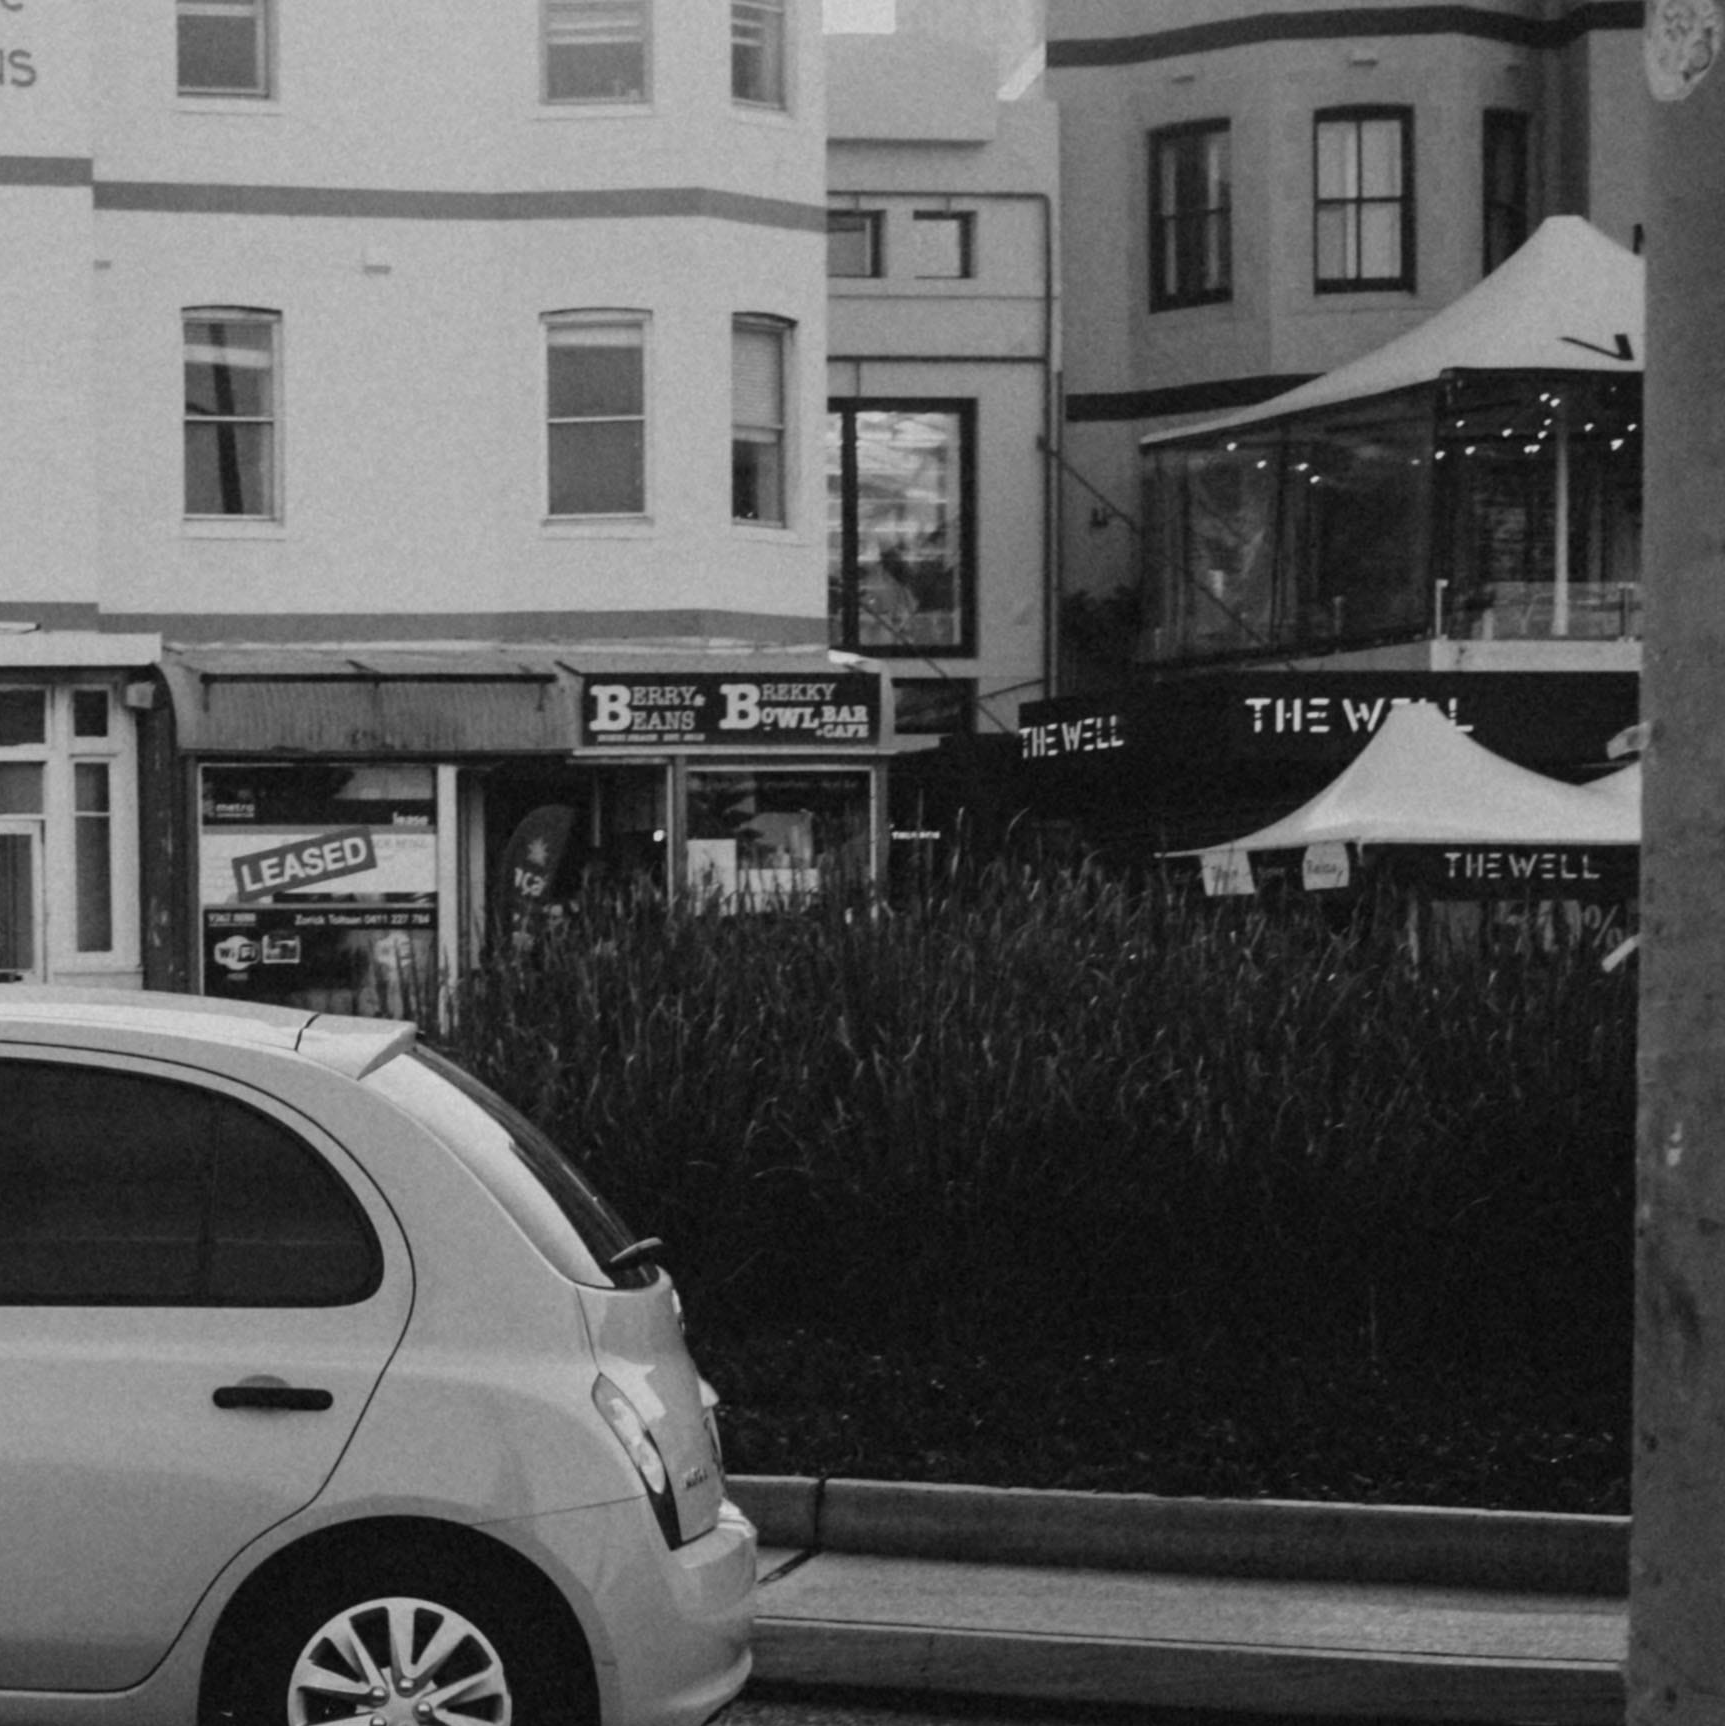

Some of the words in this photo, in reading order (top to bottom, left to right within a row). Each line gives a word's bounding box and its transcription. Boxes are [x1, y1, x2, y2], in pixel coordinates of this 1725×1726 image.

[821, 705, 869, 723] BAR
[1245, 698, 1332, 733] THE
[1341, 698, 1474, 733] WL
[1019, 724, 1059, 760] THE
[1061, 715, 1125, 753] WELL
[392, 812, 429, 825] lease
[240, 836, 368, 893] LEASED
[1444, 852, 1503, 879] THE
[1507, 853, 1601, 880] WELL
